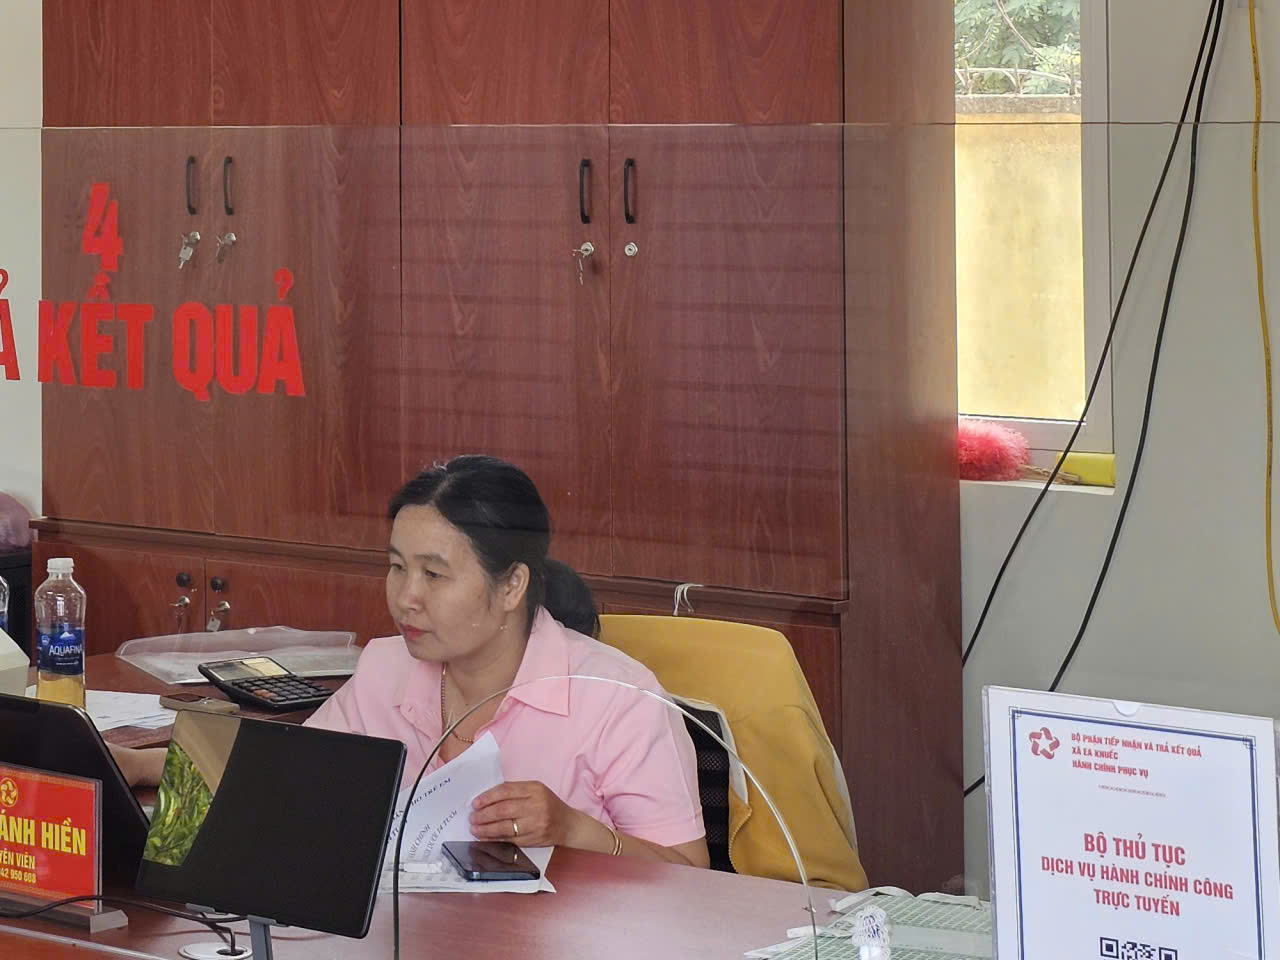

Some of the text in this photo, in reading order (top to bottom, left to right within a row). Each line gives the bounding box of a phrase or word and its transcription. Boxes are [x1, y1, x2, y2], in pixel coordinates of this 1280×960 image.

[82, 182, 123, 271] 4
[38, 272, 154, 389] KẾT
[172, 267, 305, 401] QUẢ
[41, 817, 86, 856] HIỀN
[1083, 831, 1186, 868] BỘ THỦ TỤC
[16, 851, 36, 870] VIÊN
[1041, 856, 1234, 900] DỊCH VỤ HÀNH CHÍNH CÔNG
[1094, 888, 1180, 917] TRỰC TUYẾN
